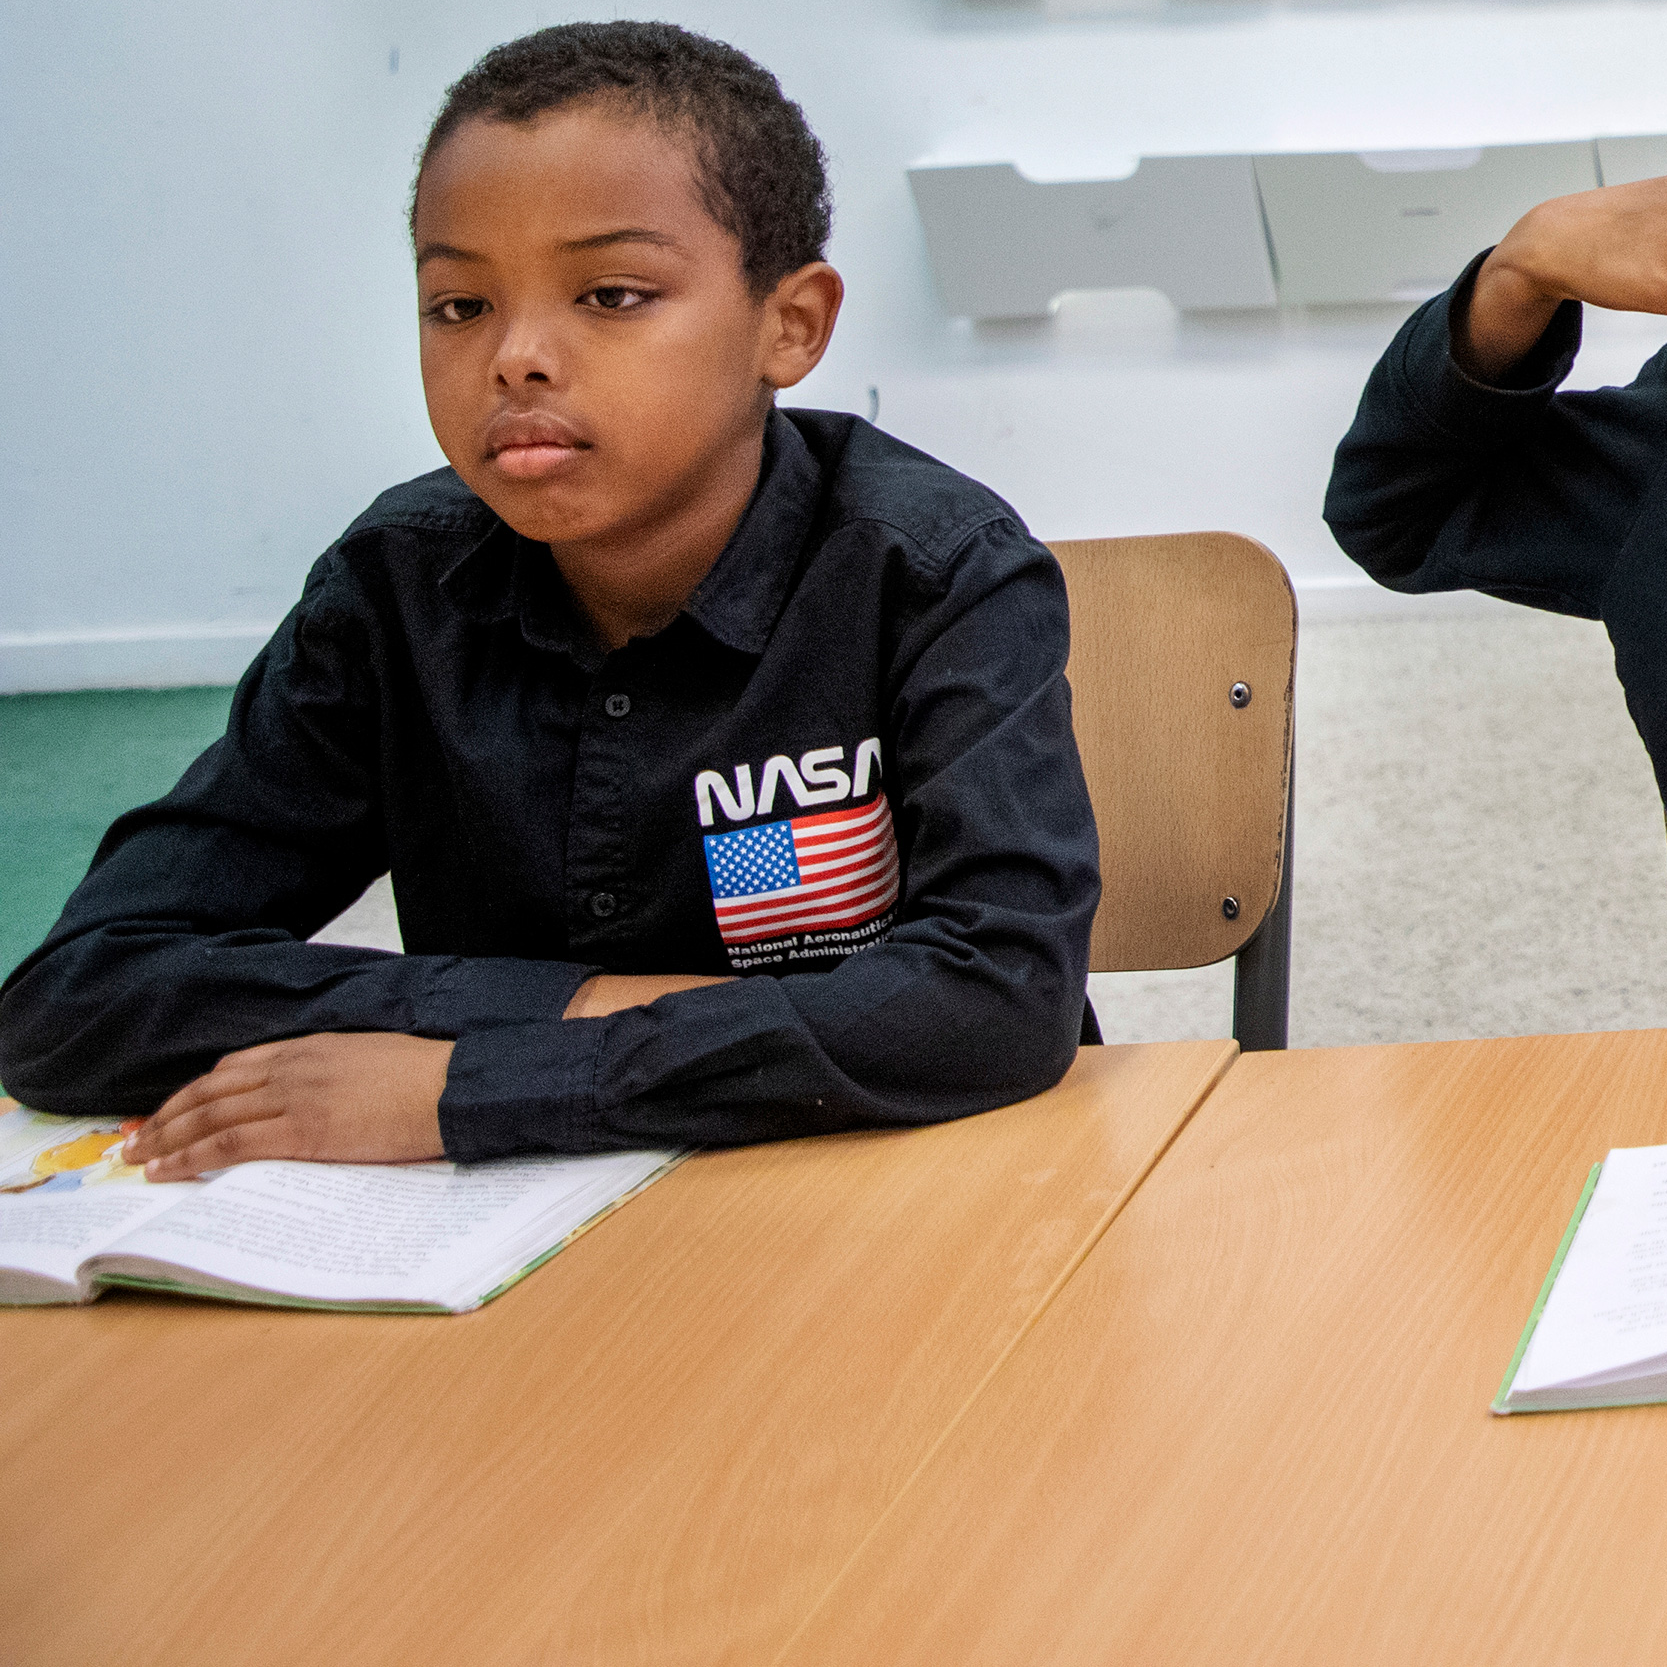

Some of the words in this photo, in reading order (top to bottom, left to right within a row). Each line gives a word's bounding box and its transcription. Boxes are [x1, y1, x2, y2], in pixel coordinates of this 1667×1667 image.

[695, 737, 882, 827] NASA
[727, 936, 798, 957] National
[731, 954, 783, 970] Space
